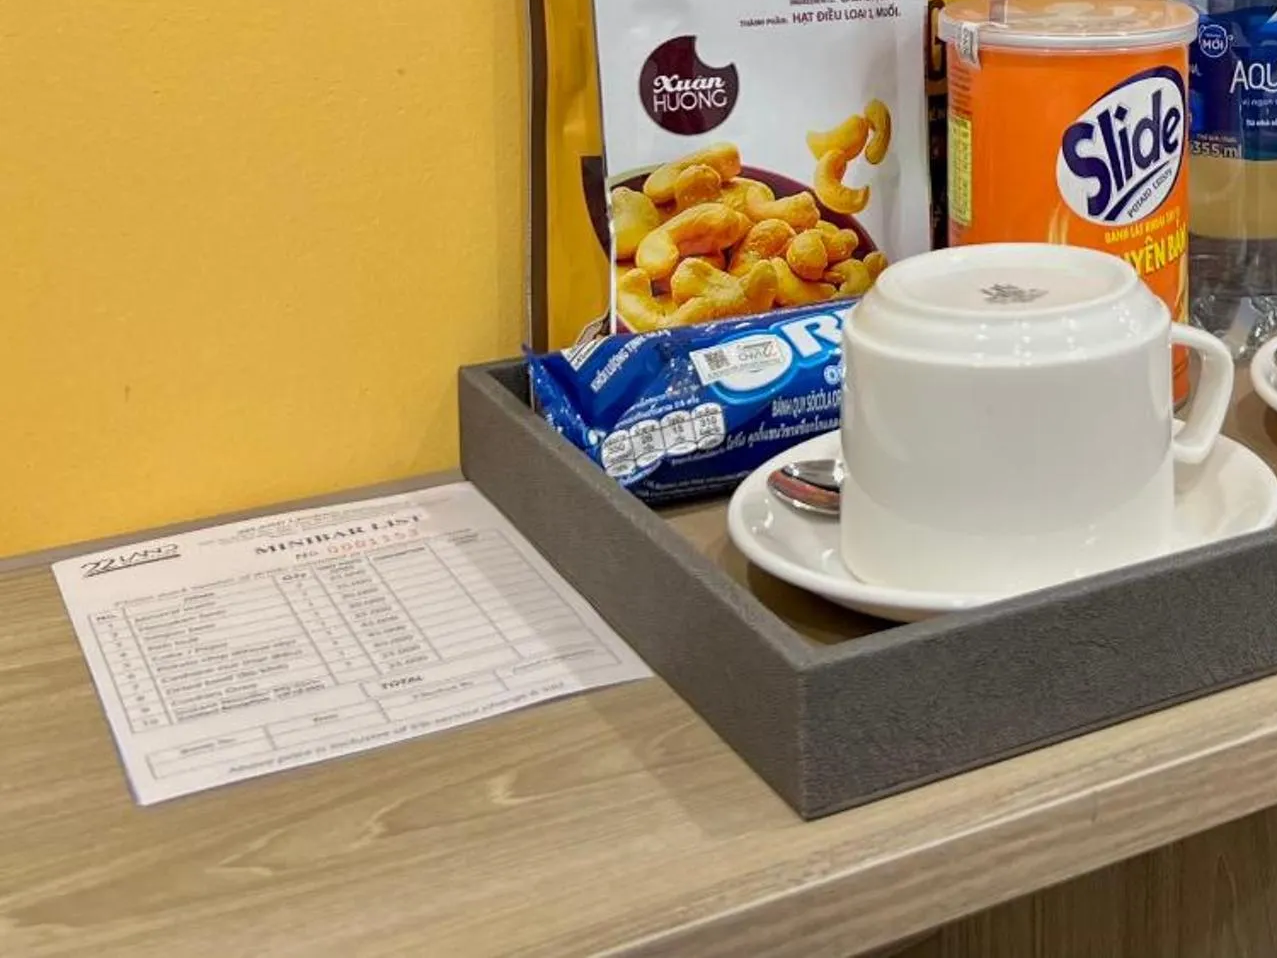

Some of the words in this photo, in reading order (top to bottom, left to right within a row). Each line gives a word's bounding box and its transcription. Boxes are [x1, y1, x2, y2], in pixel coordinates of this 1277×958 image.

[1062, 88, 1182, 217] Slide
[255, 525, 365, 555] MINIBAR
[371, 515, 421, 532] LIST
